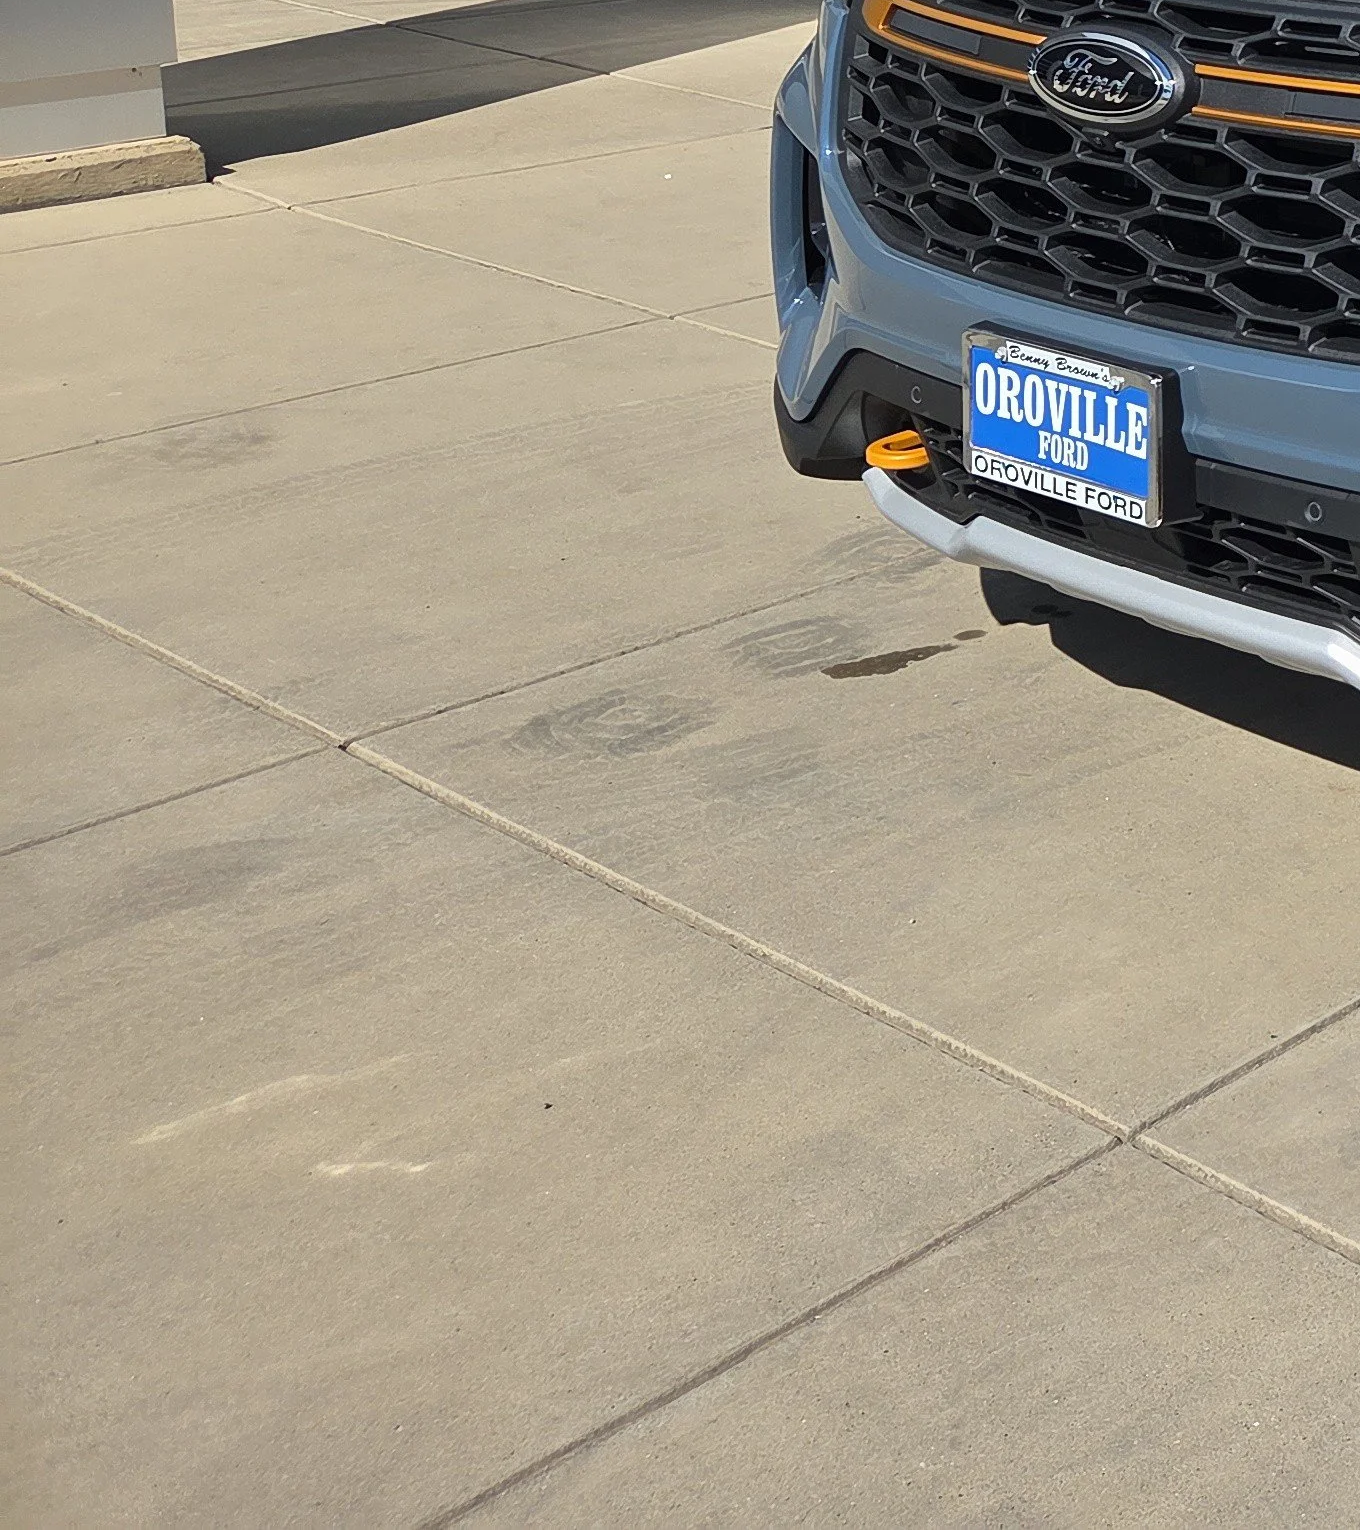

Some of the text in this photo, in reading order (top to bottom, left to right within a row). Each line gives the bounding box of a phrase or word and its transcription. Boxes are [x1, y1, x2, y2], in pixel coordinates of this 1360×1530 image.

[1053, 49, 1135, 104] Ford
[1008, 345, 1111, 383] Benny Brown's
[975, 362, 1148, 460] OROVILLE
[1037, 430, 1089, 471] FORD
[974, 454, 1143, 520] OROVILLE FORD
